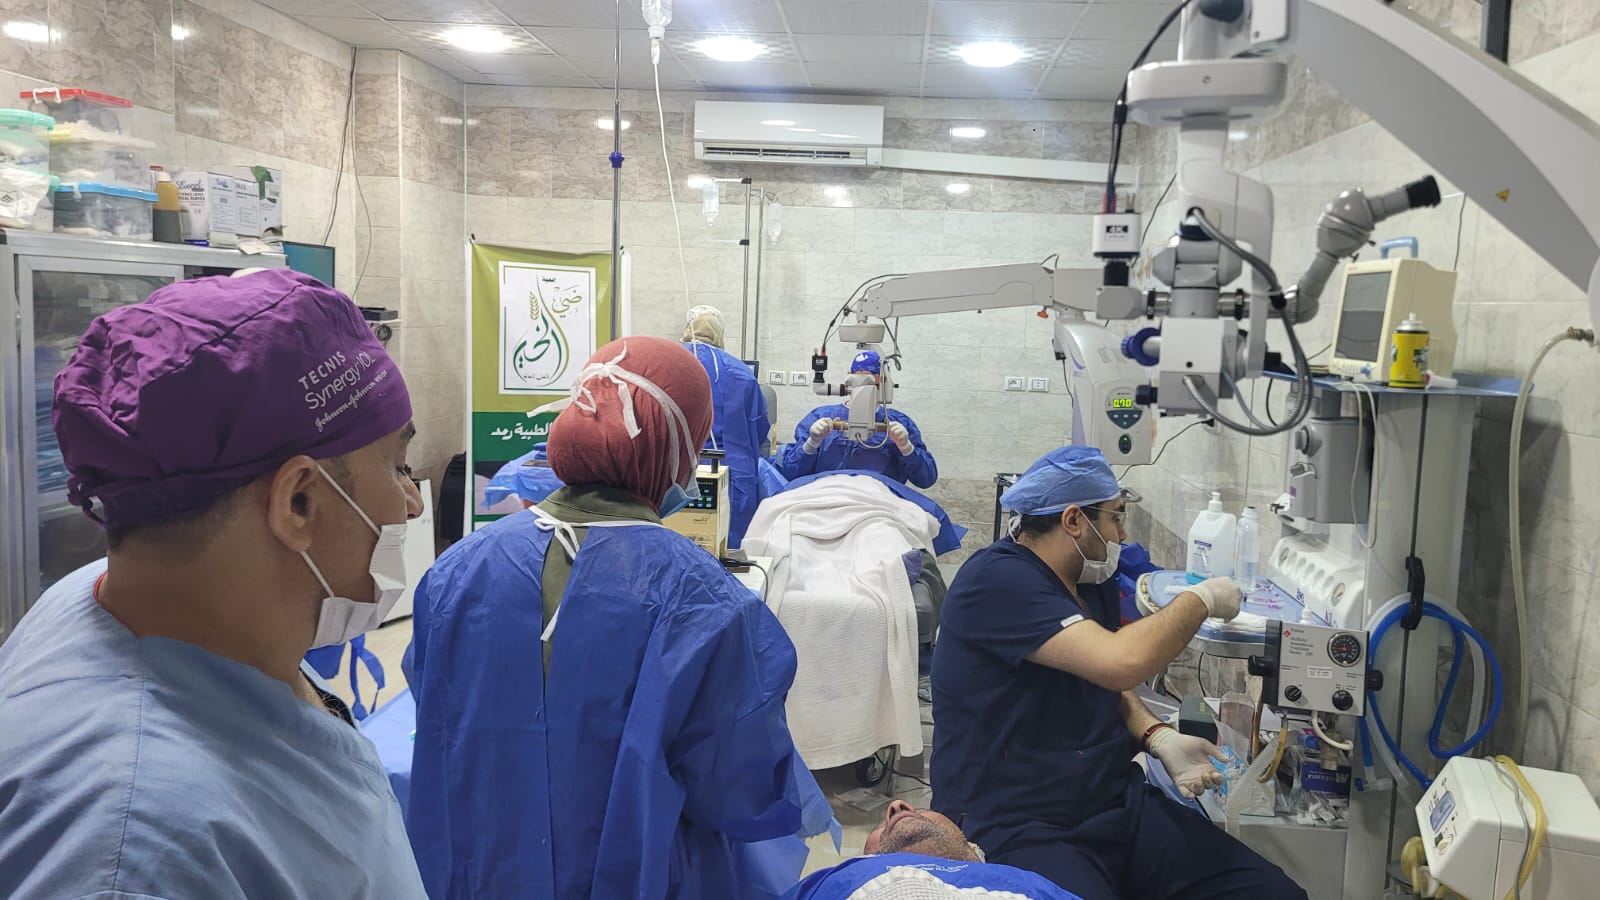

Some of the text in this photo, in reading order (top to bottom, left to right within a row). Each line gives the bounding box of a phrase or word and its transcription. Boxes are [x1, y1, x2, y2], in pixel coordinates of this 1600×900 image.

[298, 351, 346, 390] TECNIS
[305, 351, 376, 409] Synergy IOL
[490, 422, 553, 440] الطبية رمد
